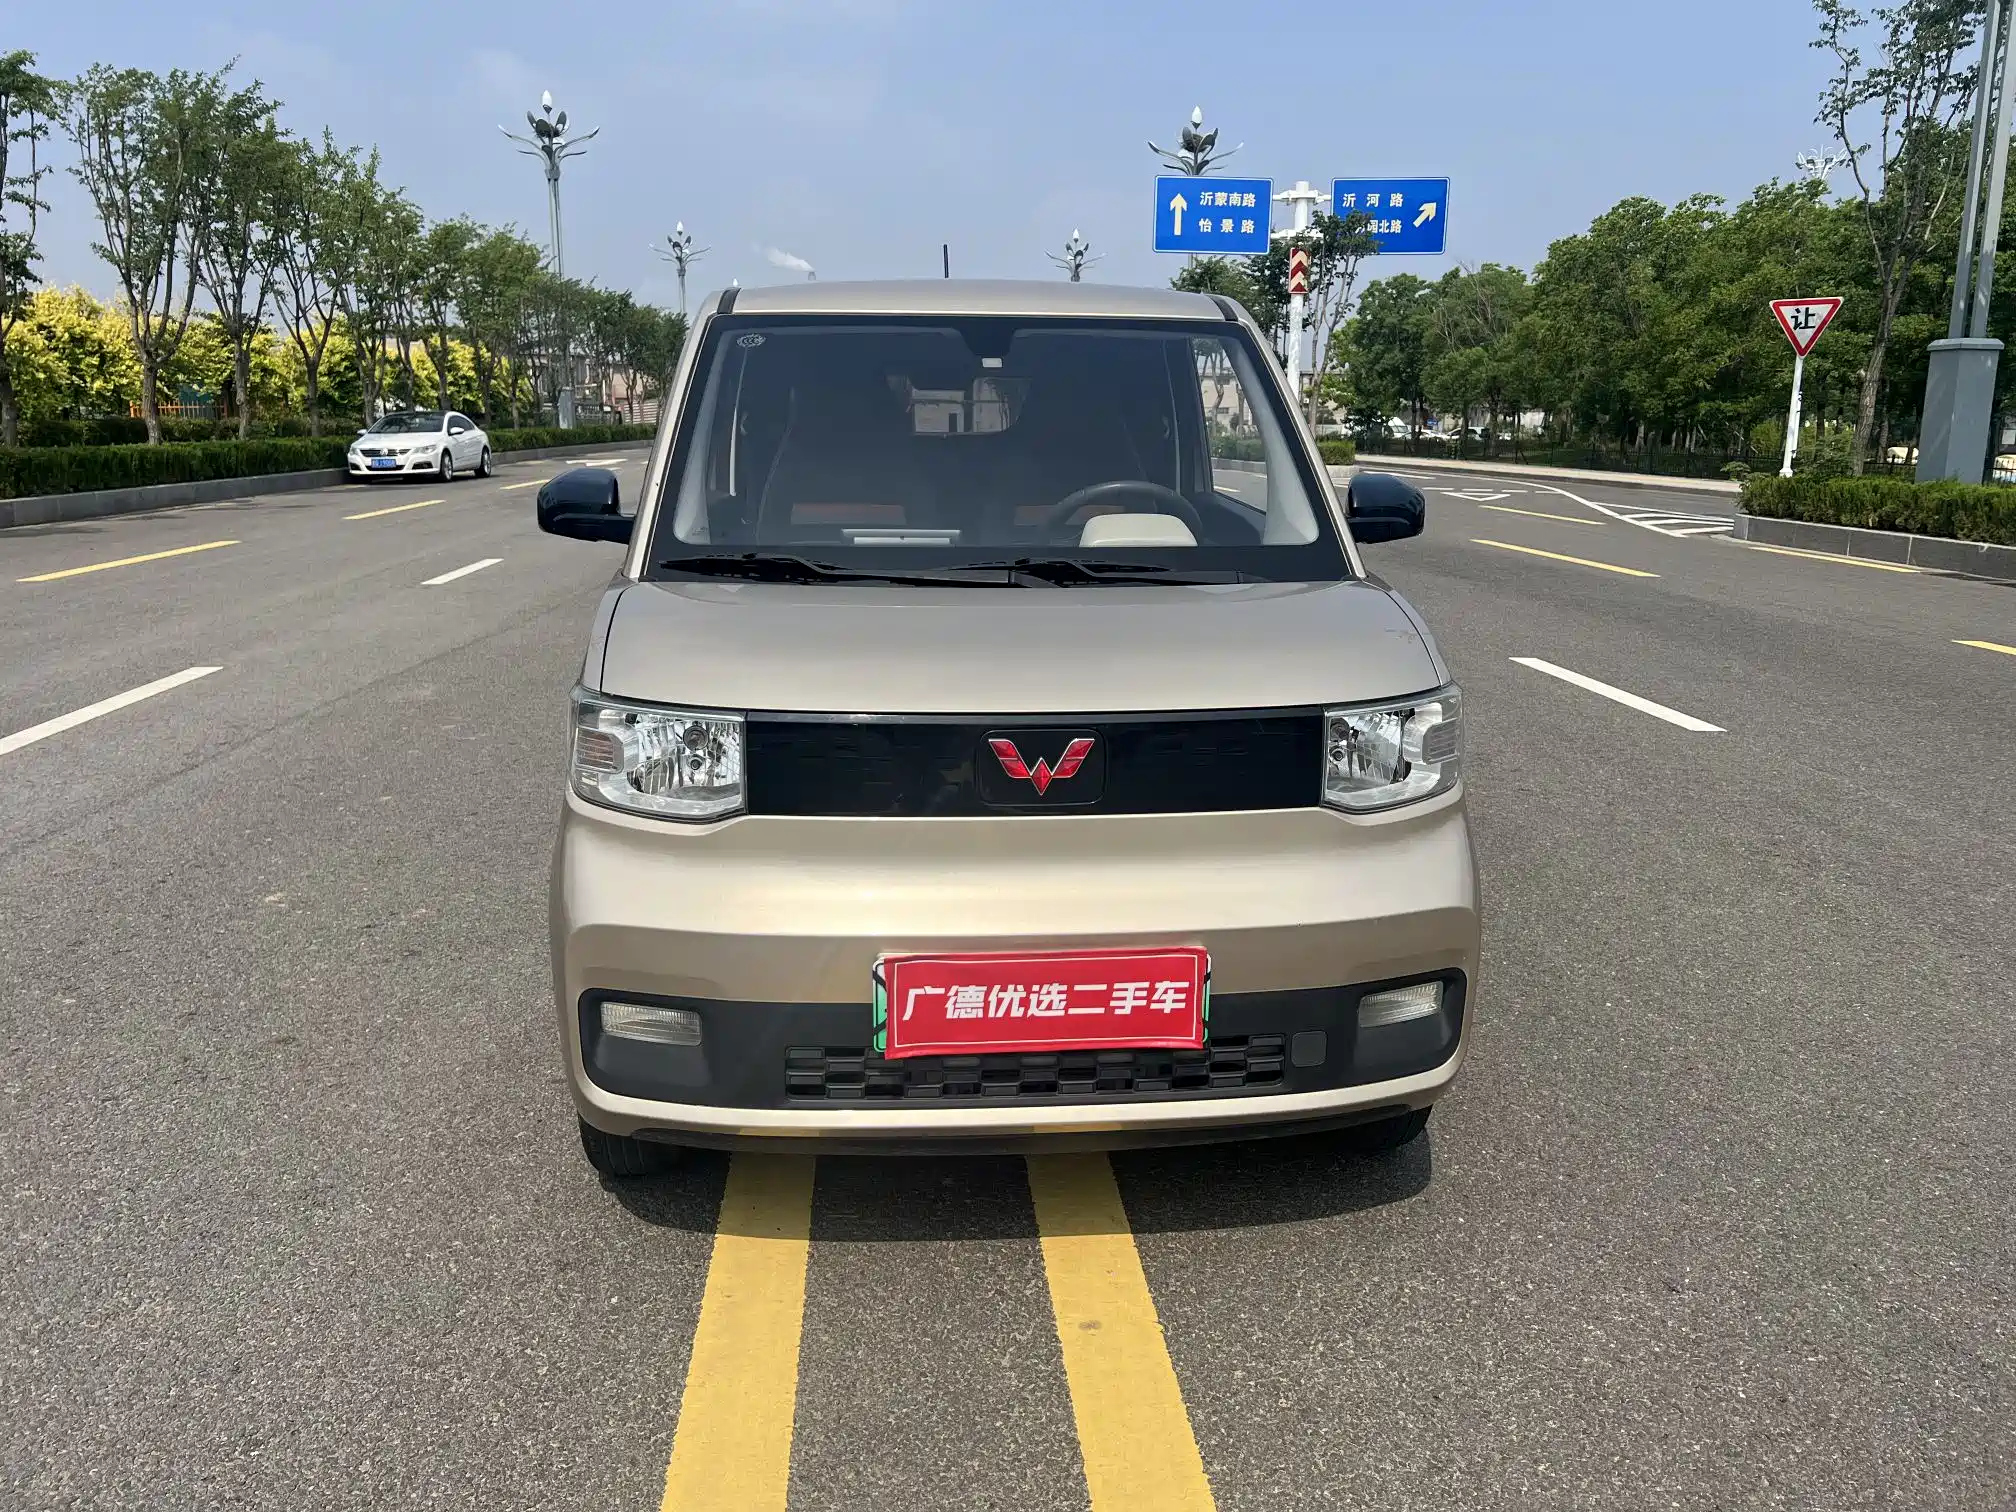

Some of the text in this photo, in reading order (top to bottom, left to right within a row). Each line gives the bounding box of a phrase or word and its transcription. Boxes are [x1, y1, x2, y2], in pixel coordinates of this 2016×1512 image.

[1200, 192, 1256, 207] 沂蒙南路
[1342, 193, 1403, 207] 沂河路
[1199, 218, 1255, 233] 怡景路
[1791, 307, 1816, 330] 让
[903, 981, 1190, 1021] 广德优选二手车
